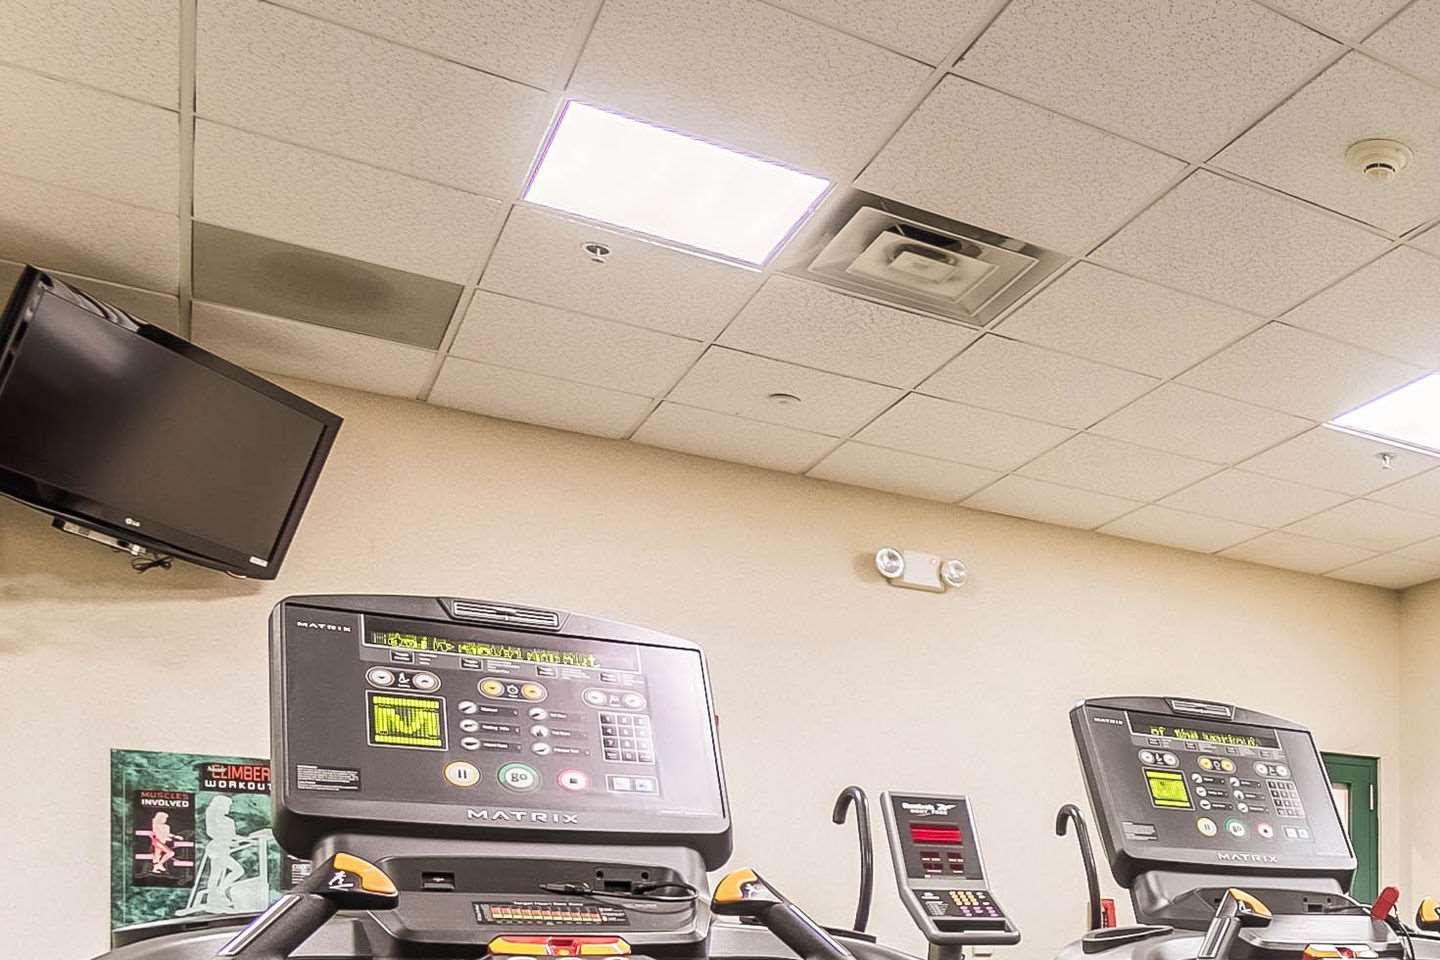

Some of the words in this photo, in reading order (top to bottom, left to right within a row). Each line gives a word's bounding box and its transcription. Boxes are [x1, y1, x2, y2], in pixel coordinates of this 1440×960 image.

[296, 621, 352, 632] MATRIX
[510, 772, 528, 783] go
[141, 799, 189, 808] INVOLVED
[466, 808, 579, 825] MATRIX
[1217, 852, 1279, 864] MATRIX
